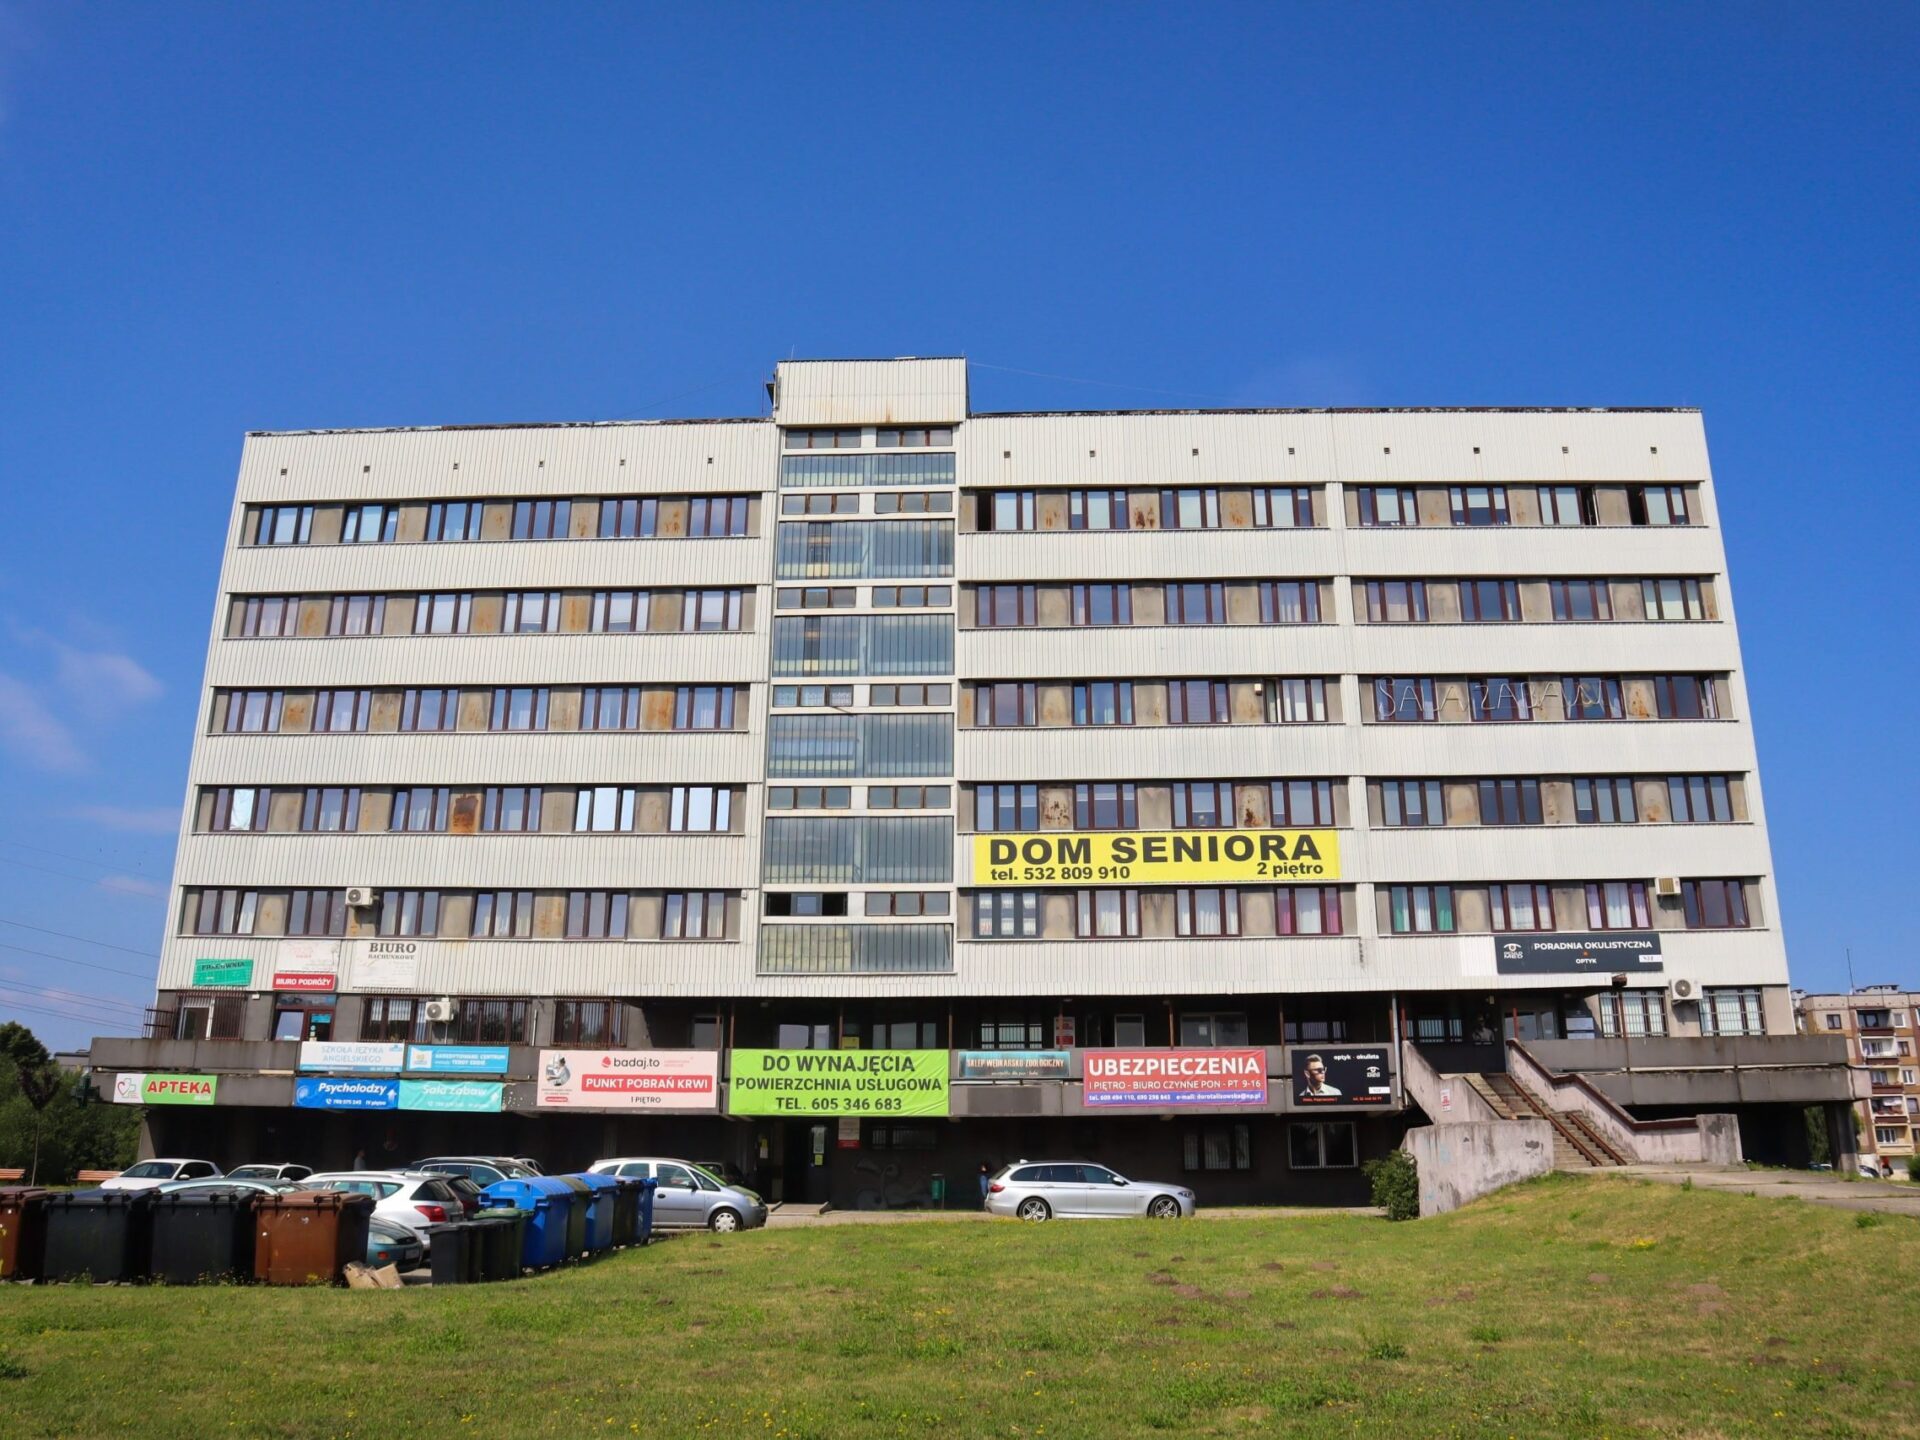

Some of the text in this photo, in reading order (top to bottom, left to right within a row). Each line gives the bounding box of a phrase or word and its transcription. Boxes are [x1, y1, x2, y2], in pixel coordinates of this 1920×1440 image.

[990, 834, 1322, 865] DOM SENIORA
[991, 866, 1130, 881] tel. 532 809 910
[1257, 861, 1324, 878] 2 piętro
[369, 942, 417, 953] BIURO
[1533, 941, 1652, 950] PORADNIA OKULISTYCZNA
[298, 976, 331, 986] PODRÓŻY
[323, 1055, 382, 1063] ANGIELSKIEGO
[613, 1056, 660, 1070] badaj.to
[762, 1055, 915, 1076] DO WYNAJĘCIA
[1089, 1056, 1261, 1076] UBEZPIECZENIA
[147, 1081, 211, 1094] APTEKA
[586, 1075, 708, 1089] PUNKT POBRAŃ KRWI
[735, 1077, 942, 1091] POWIERZCHNIA USŁUGOWA
[1094, 1081, 1126, 1091] PIĘTRO
[1133, 1080, 1160, 1090] BIURO
[1163, 1080, 1199, 1090] CZYNNE
[1202, 1080, 1221, 1089] PON
[1227, 1080, 1238, 1088] PT
[1242, 1079, 1261, 1088] 9-16
[318, 1082, 387, 1096] Psycholodzy
[423, 1085, 447, 1094] Sala
[635, 1096, 661, 1105] PIĘTRO
[776, 1097, 902, 1110] TEL. 605 346 683
